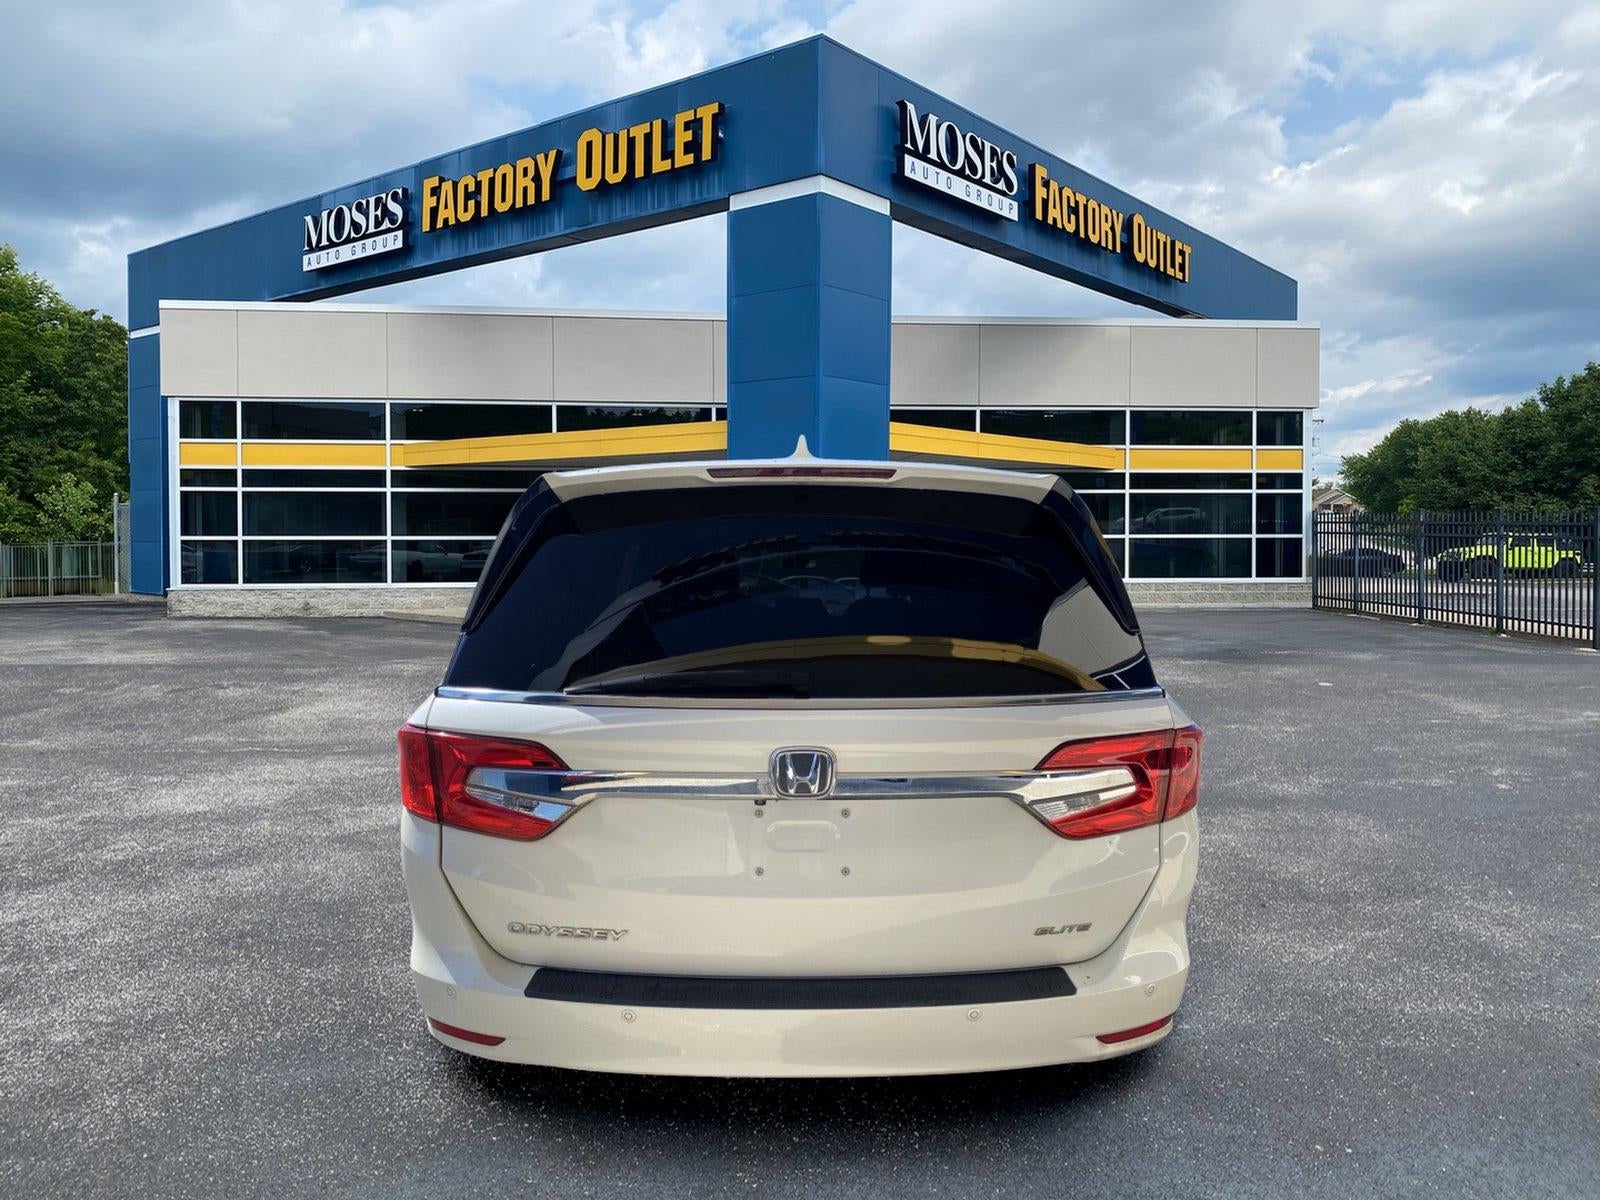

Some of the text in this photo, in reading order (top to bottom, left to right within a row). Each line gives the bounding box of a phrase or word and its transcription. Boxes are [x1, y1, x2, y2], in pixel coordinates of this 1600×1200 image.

[421, 101, 721, 233] FACTORY OUTLET
[903, 99, 1019, 196] MOSES
[909, 161, 1014, 215] AUTO GROUP
[303, 187, 404, 251] MOSES
[1034, 163, 1192, 283] FACTORY OUTLET
[306, 234, 400, 268] AUTO GROUP
[507, 921, 629, 941] ODYSSEY
[1034, 922, 1093, 936] ELITE
